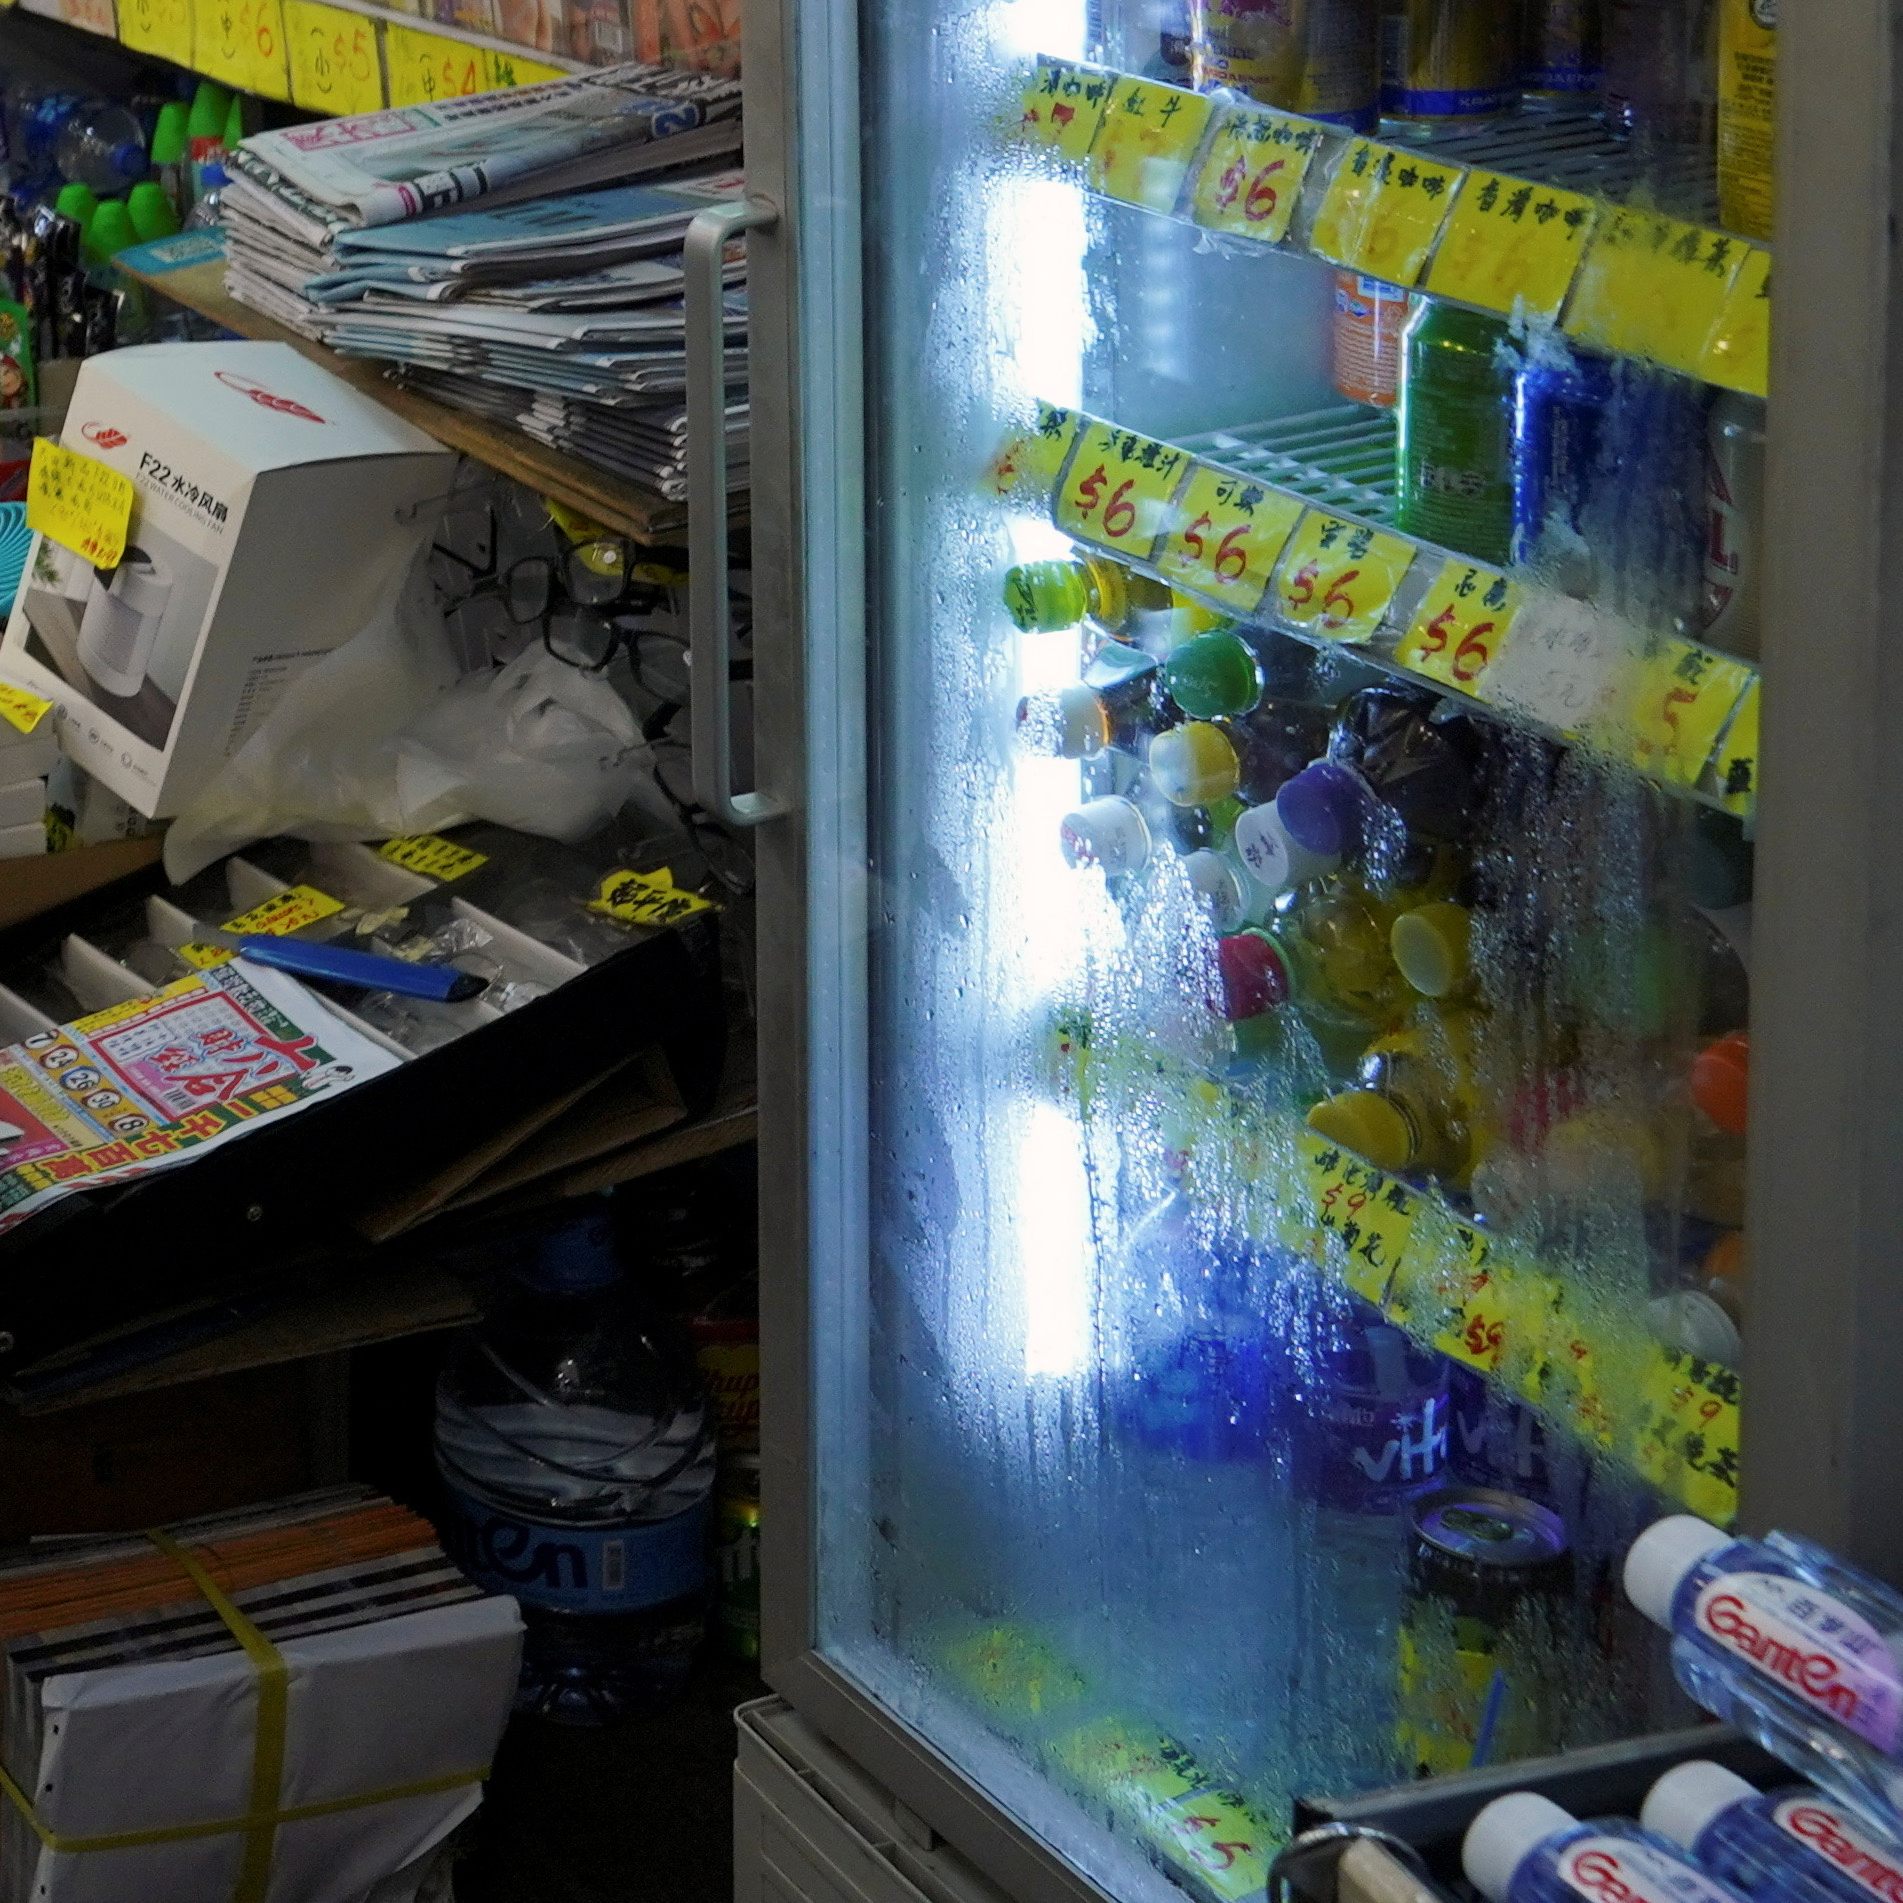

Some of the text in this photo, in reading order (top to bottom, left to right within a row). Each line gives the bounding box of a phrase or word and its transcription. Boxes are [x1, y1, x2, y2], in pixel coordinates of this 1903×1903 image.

[1215, 154, 1285, 222] $6
[140, 451, 229, 524] F22 水冷风扇
[1074, 462, 1136, 538] $6
[1214, 479, 1265, 518] 可樂
[1177, 510, 1253, 584] $6
[1287, 557, 1362, 630] $6
[1416, 602, 1497, 683] $6
[1704, 1593, 1860, 1723] Ganten
